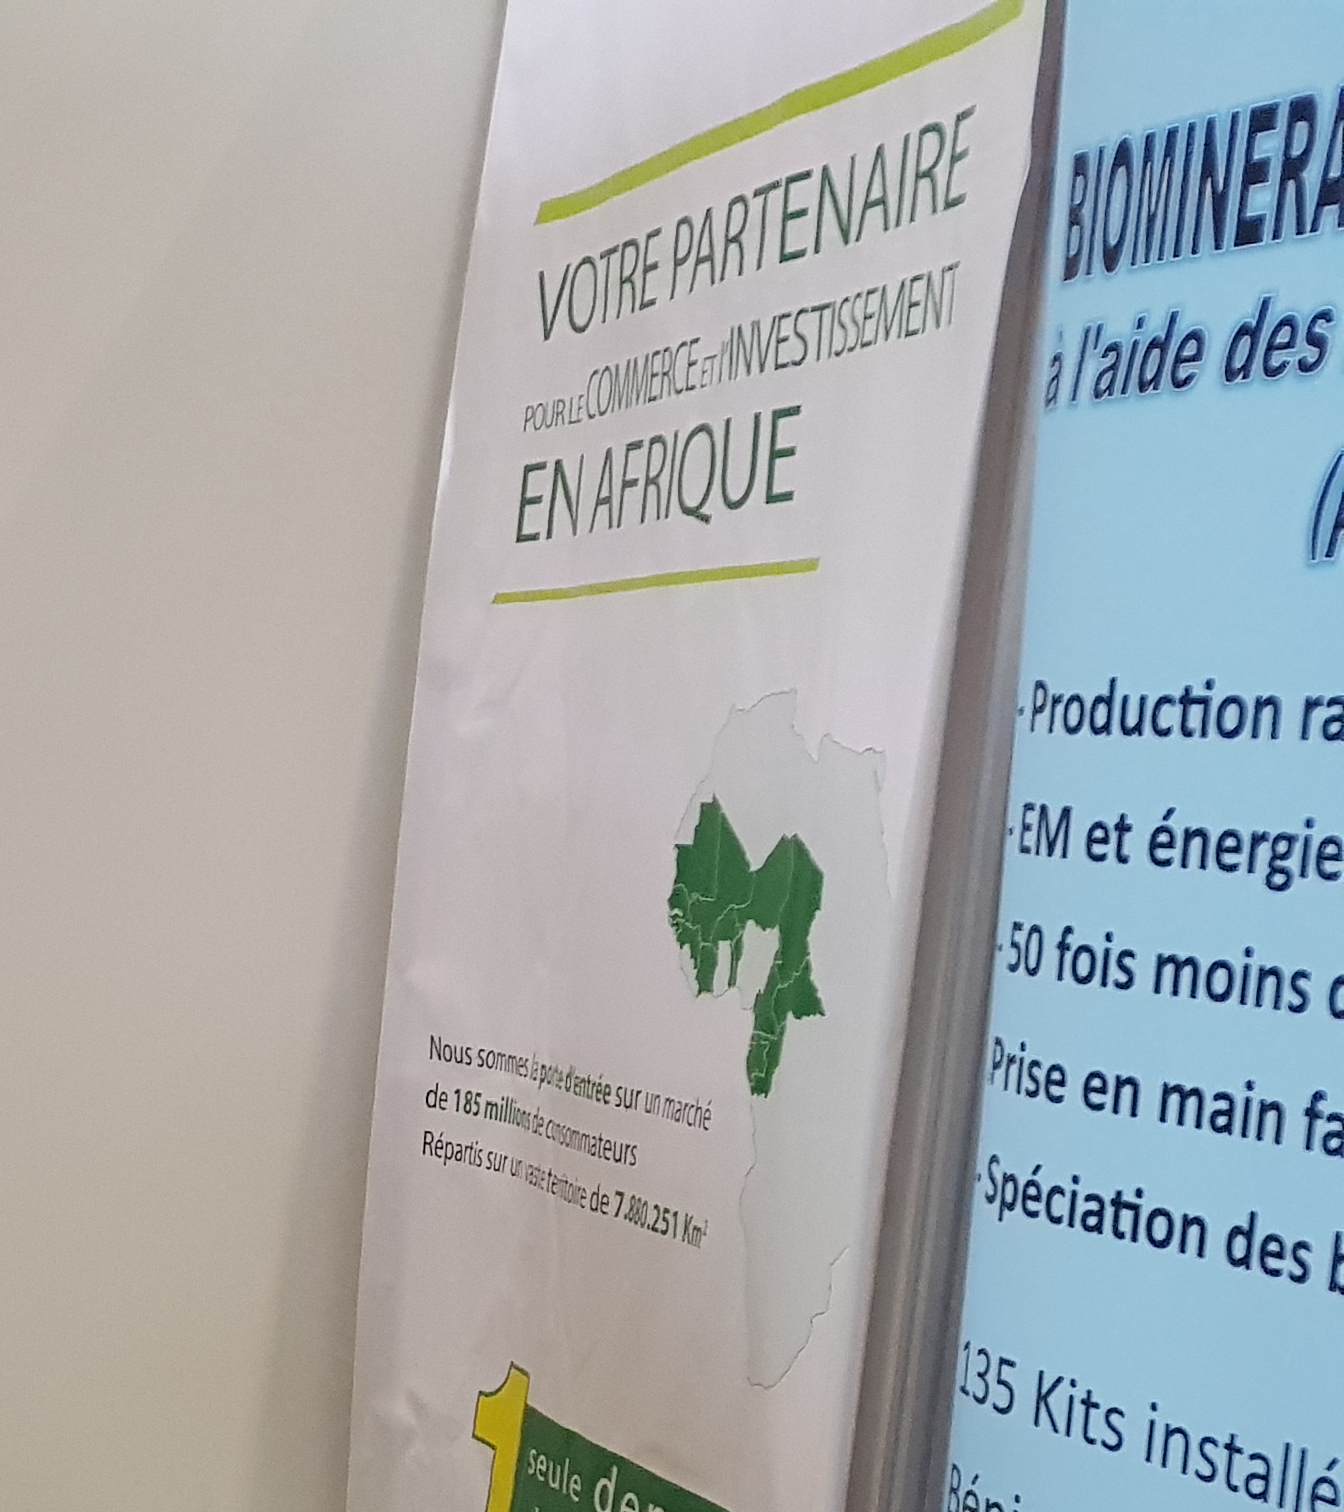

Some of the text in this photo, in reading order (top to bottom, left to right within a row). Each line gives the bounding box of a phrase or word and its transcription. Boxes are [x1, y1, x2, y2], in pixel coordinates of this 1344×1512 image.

[537, 104, 976, 342] VOTRE PARTENAIRE
[523, 399, 566, 432] POUR
[568, 394, 584, 425] LE
[585, 337, 701, 420] COMMERCE
[1045, 295, 1336, 409] à l'aide des
[515, 405, 801, 543] EN AFRIQUE
[1029, 678, 1282, 741] Production
[1019, 802, 1344, 891] EM et énergie
[1007, 921, 1044, 977] 50
[1056, 925, 1136, 990] fois
[1152, 946, 1310, 1014] moins
[425, 1082, 637, 1166] de 185 millions de consommateurs
[429, 1034, 472, 1066] Nous
[477, 1048, 529, 1078] sommes
[614, 1085, 642, 1111] sur
[645, 1091, 660, 1115] un
[662, 1096, 712, 1131] marché
[991, 1036, 1066, 1103] Prise
[1082, 1069, 1139, 1118] en
[1158, 1080, 1286, 1146] main
[423, 1130, 483, 1166] Répartis
[486, 1150, 508, 1174] sur
[589, 1183, 610, 1215] de
[985, 1153, 1207, 1259] Spéciation
[1225, 1211, 1312, 1285] des
[959, 1339, 1016, 1416] 135
[1033, 1369, 1126, 1452] Kits
[527, 1447, 582, 1502] seule
